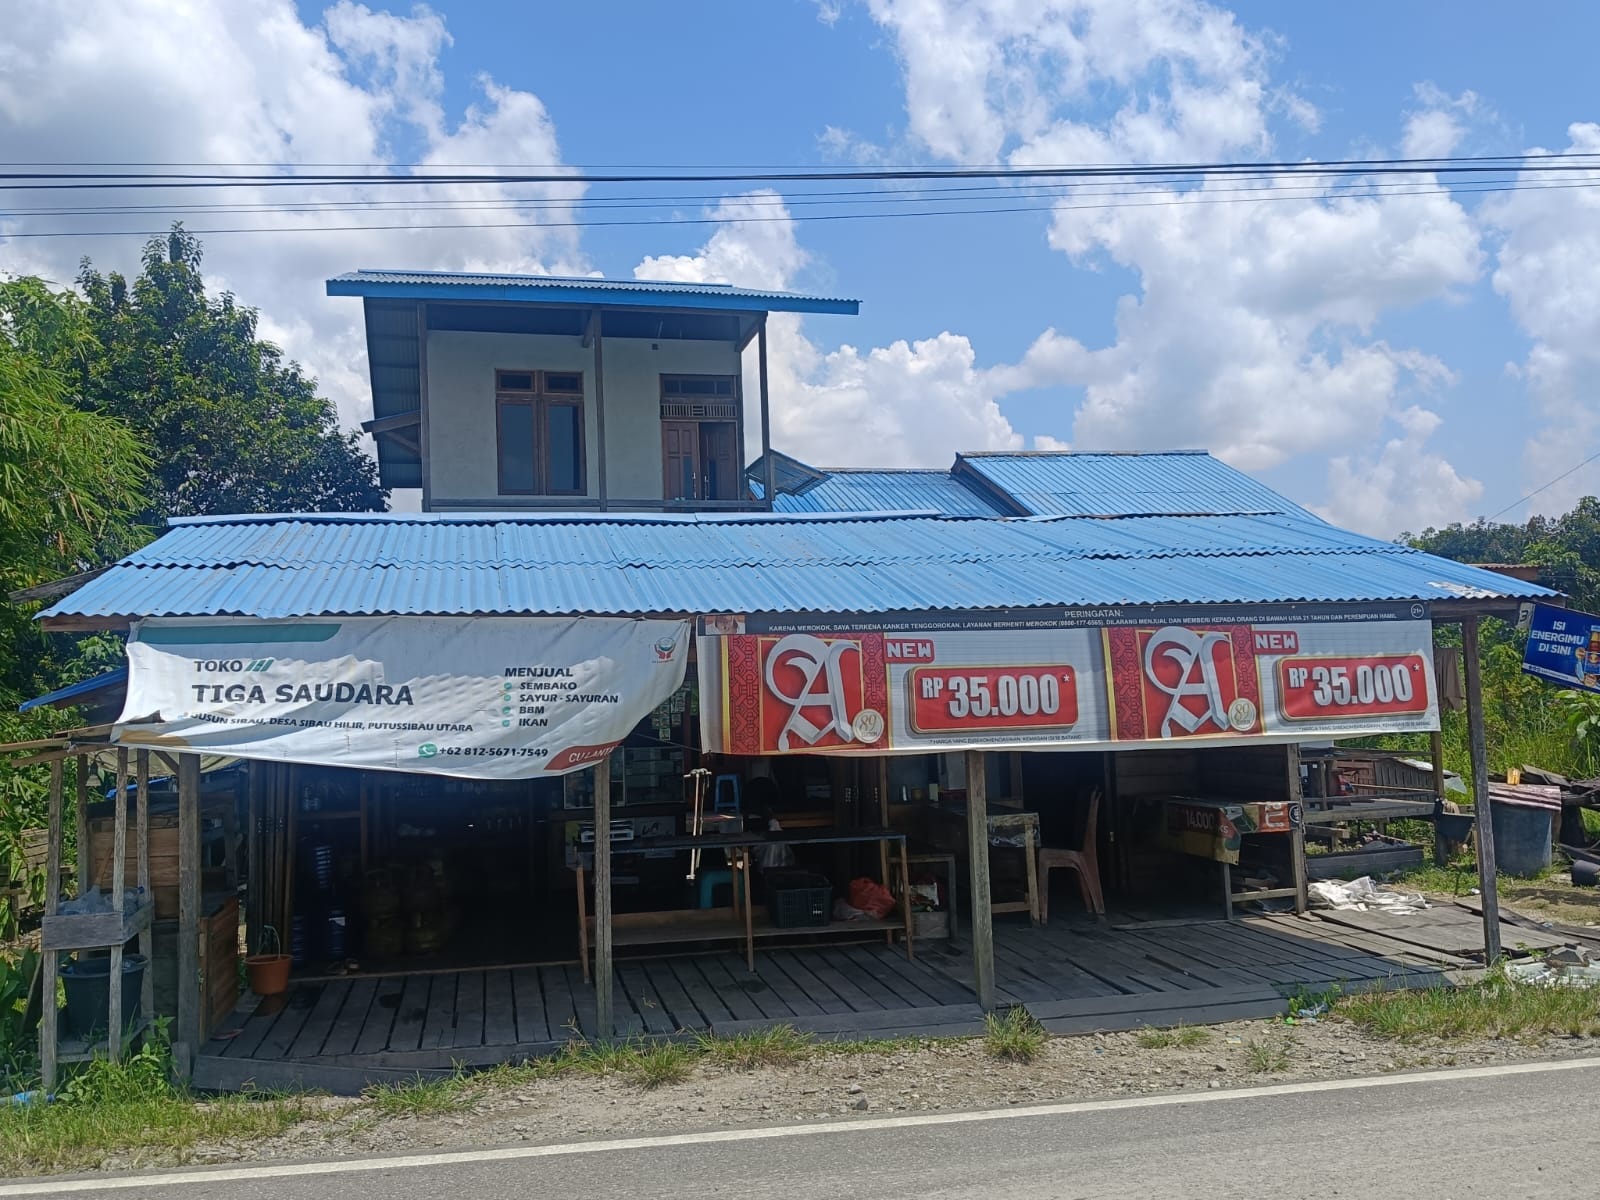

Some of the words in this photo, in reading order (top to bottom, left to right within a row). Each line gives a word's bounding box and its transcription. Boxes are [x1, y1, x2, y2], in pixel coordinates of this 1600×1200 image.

[1064, 609, 1124, 618] PERINGATAN:
[768, 624, 796, 632] KARENA
[851, 623, 881, 631] TERKENA
[882, 622, 909, 630] KANKER
[962, 621, 992, 629] LAYANAN
[1106, 618, 1138, 626] DILARANG
[1552, 620, 1566, 632] ISI
[1254, 634, 1297, 650] NEW
[1530, 629, 1585, 645] ENERGIMU
[886, 642, 932, 658] NEW
[1538, 642, 1550, 653] DI
[1551, 644, 1572, 656] SINI
[194, 660, 243, 673] TOKO
[504, 667, 574, 677] MENJUAL
[1287, 667, 1308, 688] RP
[519, 682, 577, 690] SEMBAKO
[921, 676, 944, 699] RP
[192, 684, 266, 704] TIGA
[274, 682, 414, 705] SAUDARA
[519, 693, 558, 703] SAYUR
[565, 693, 619, 703] SAYURAN
[519, 706, 545, 714] BBM
[269, 717, 297, 727] DESA
[298, 719, 332, 728] SIBAU
[334, 721, 365, 730] HILIR,
[367, 722, 434, 731] PUTUSSIBAU
[436, 723, 474, 732] UTARA
[518, 718, 548, 727] IKAN
[439, 746, 461, 757] +62
[463, 746, 549, 758] 812-5671-7549
